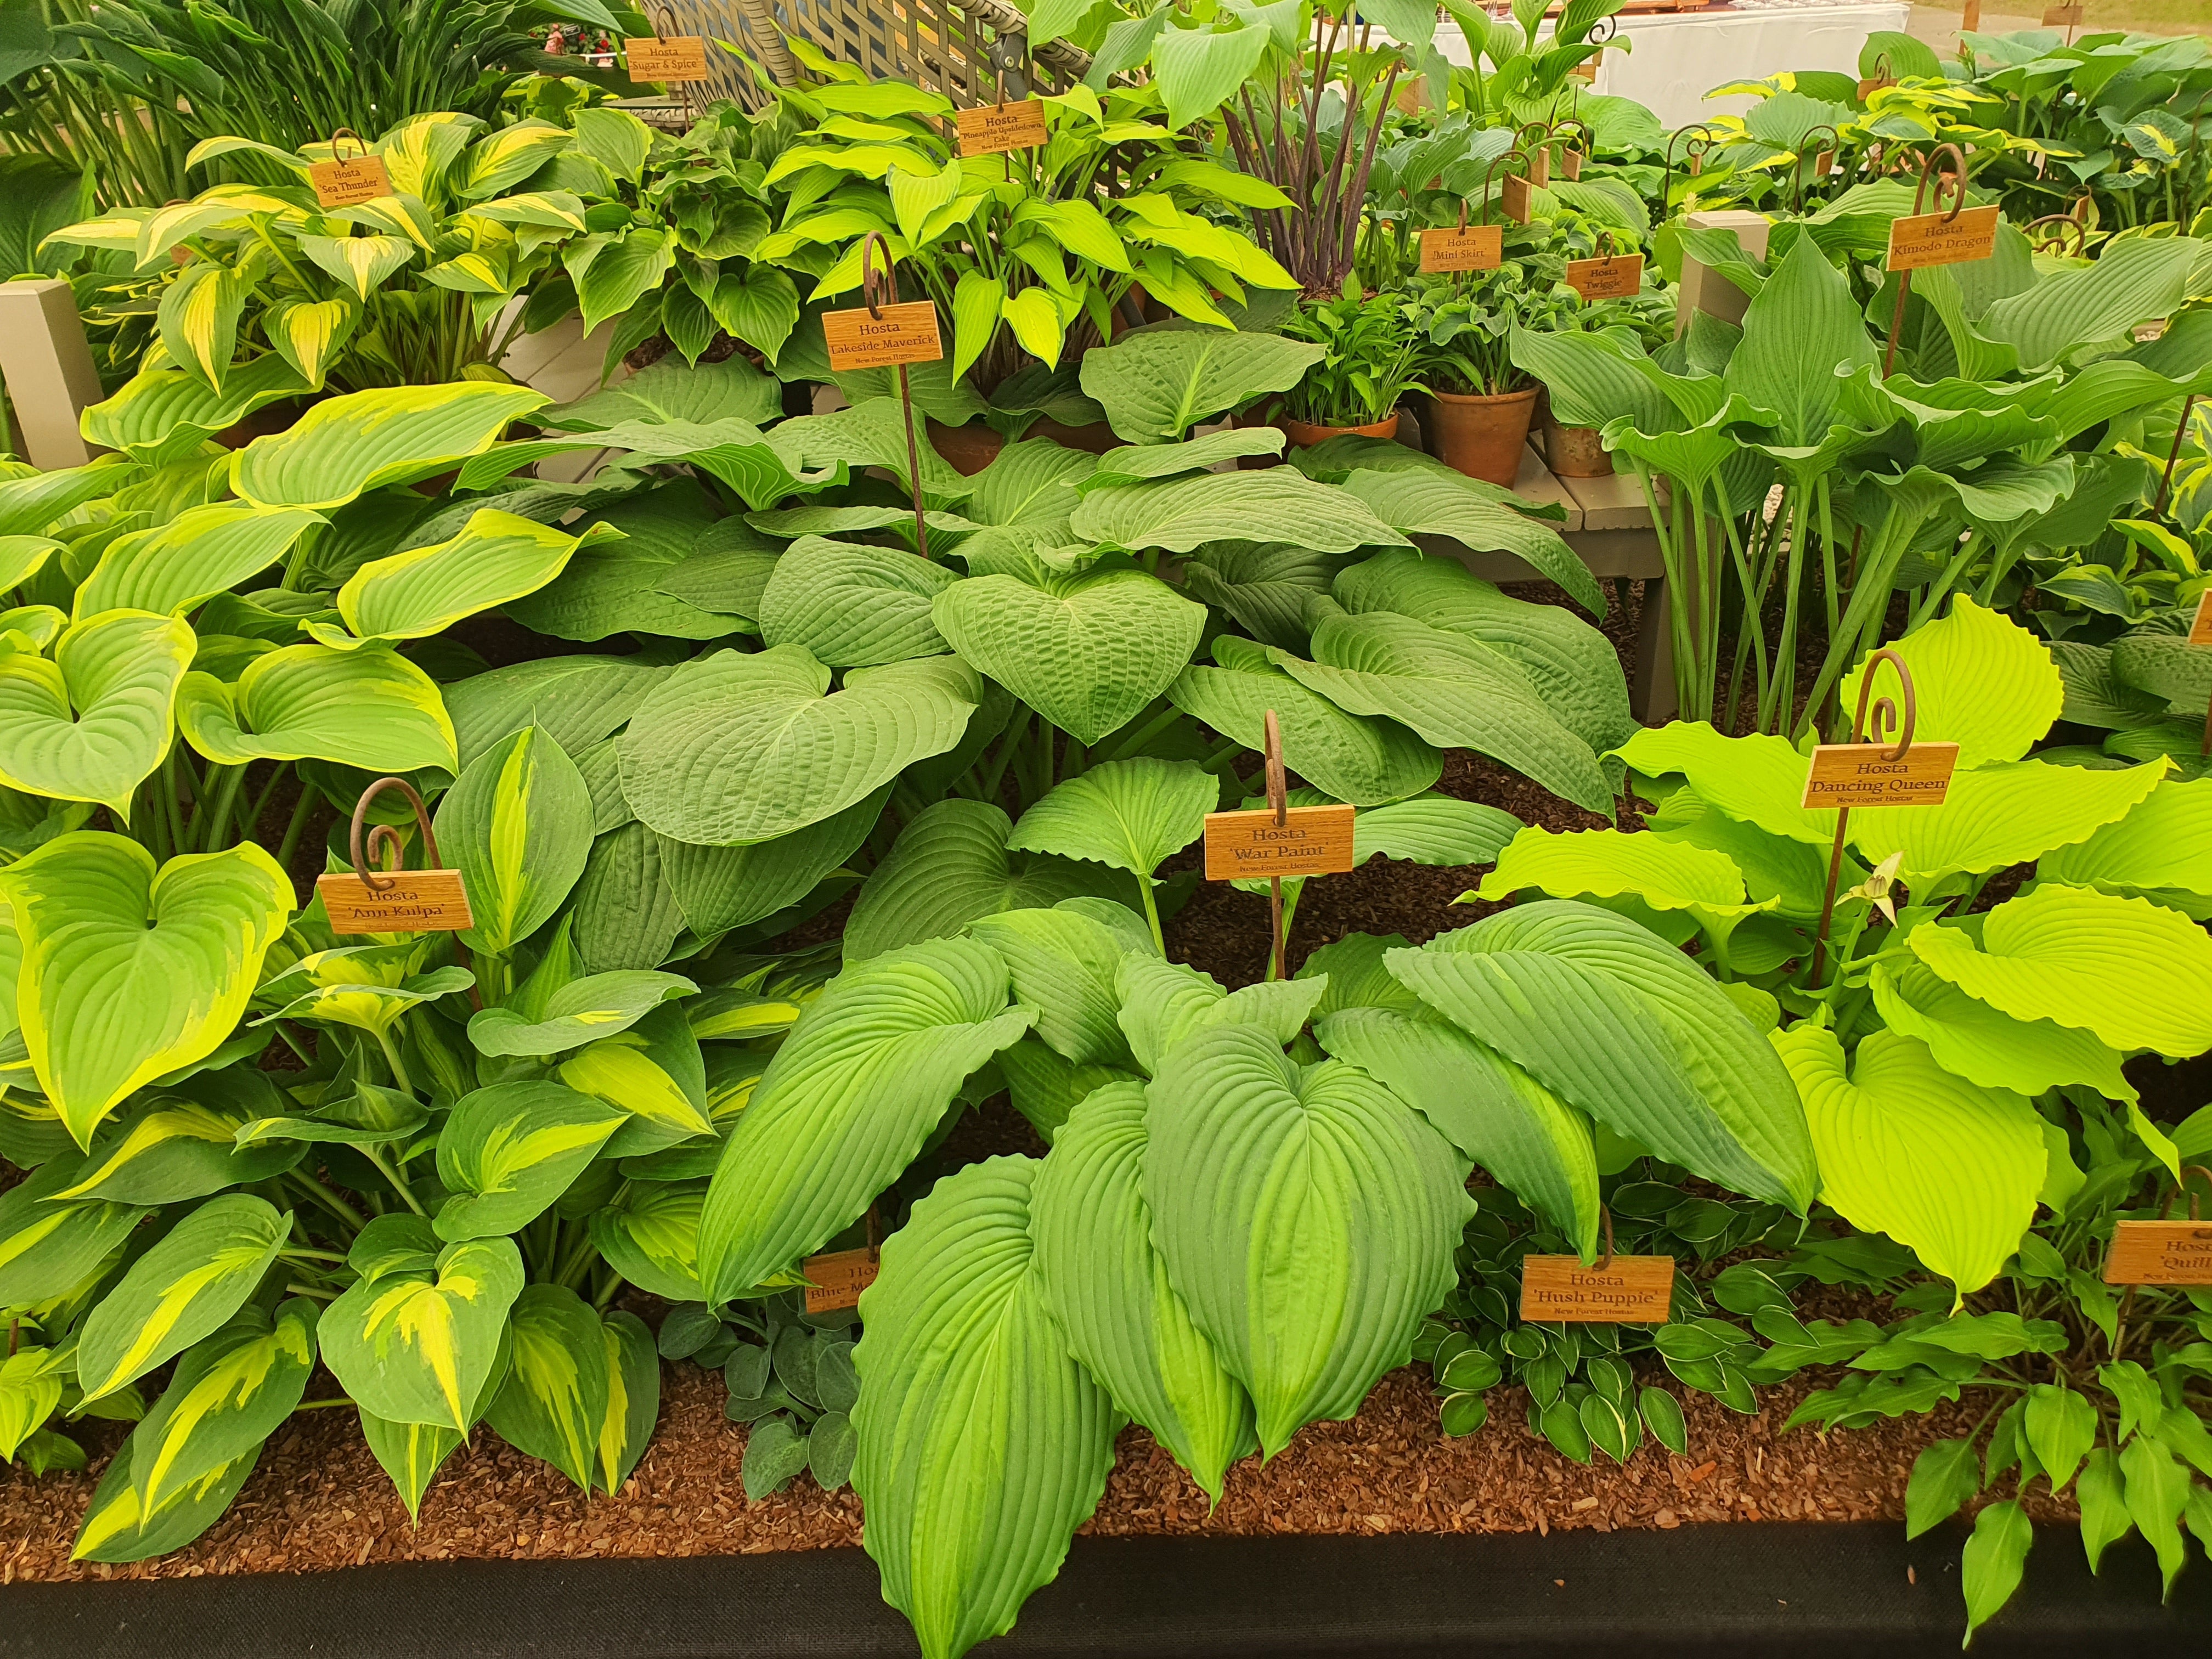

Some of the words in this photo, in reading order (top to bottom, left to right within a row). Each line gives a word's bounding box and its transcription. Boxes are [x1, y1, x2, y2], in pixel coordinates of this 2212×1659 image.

[663, 60, 669, 68] &
[985, 116, 1018, 127] Hosta
[334, 170, 361, 179] Hosta
[1926, 225, 1963, 237] Hosta
[1591, 269, 1618, 277] Hosta
[859, 324, 900, 336] Hosta
[883, 333, 937, 349] Maverick'
[1857, 763, 1908, 774] Hosta
[1252, 829, 1306, 841] Hosta
[1230, 848, 1272, 860] 'War
[1278, 842, 1329, 857] Paint'
[366, 891, 418, 901] Hosta
[348, 907, 387, 918] 'Ann
[393, 904, 445, 918] Kulpa'
[1571, 1274, 1624, 1286] Hosta
[1534, 1289, 1584, 1302] 'Hush
[1592, 1290, 1658, 1307] Puppie'
